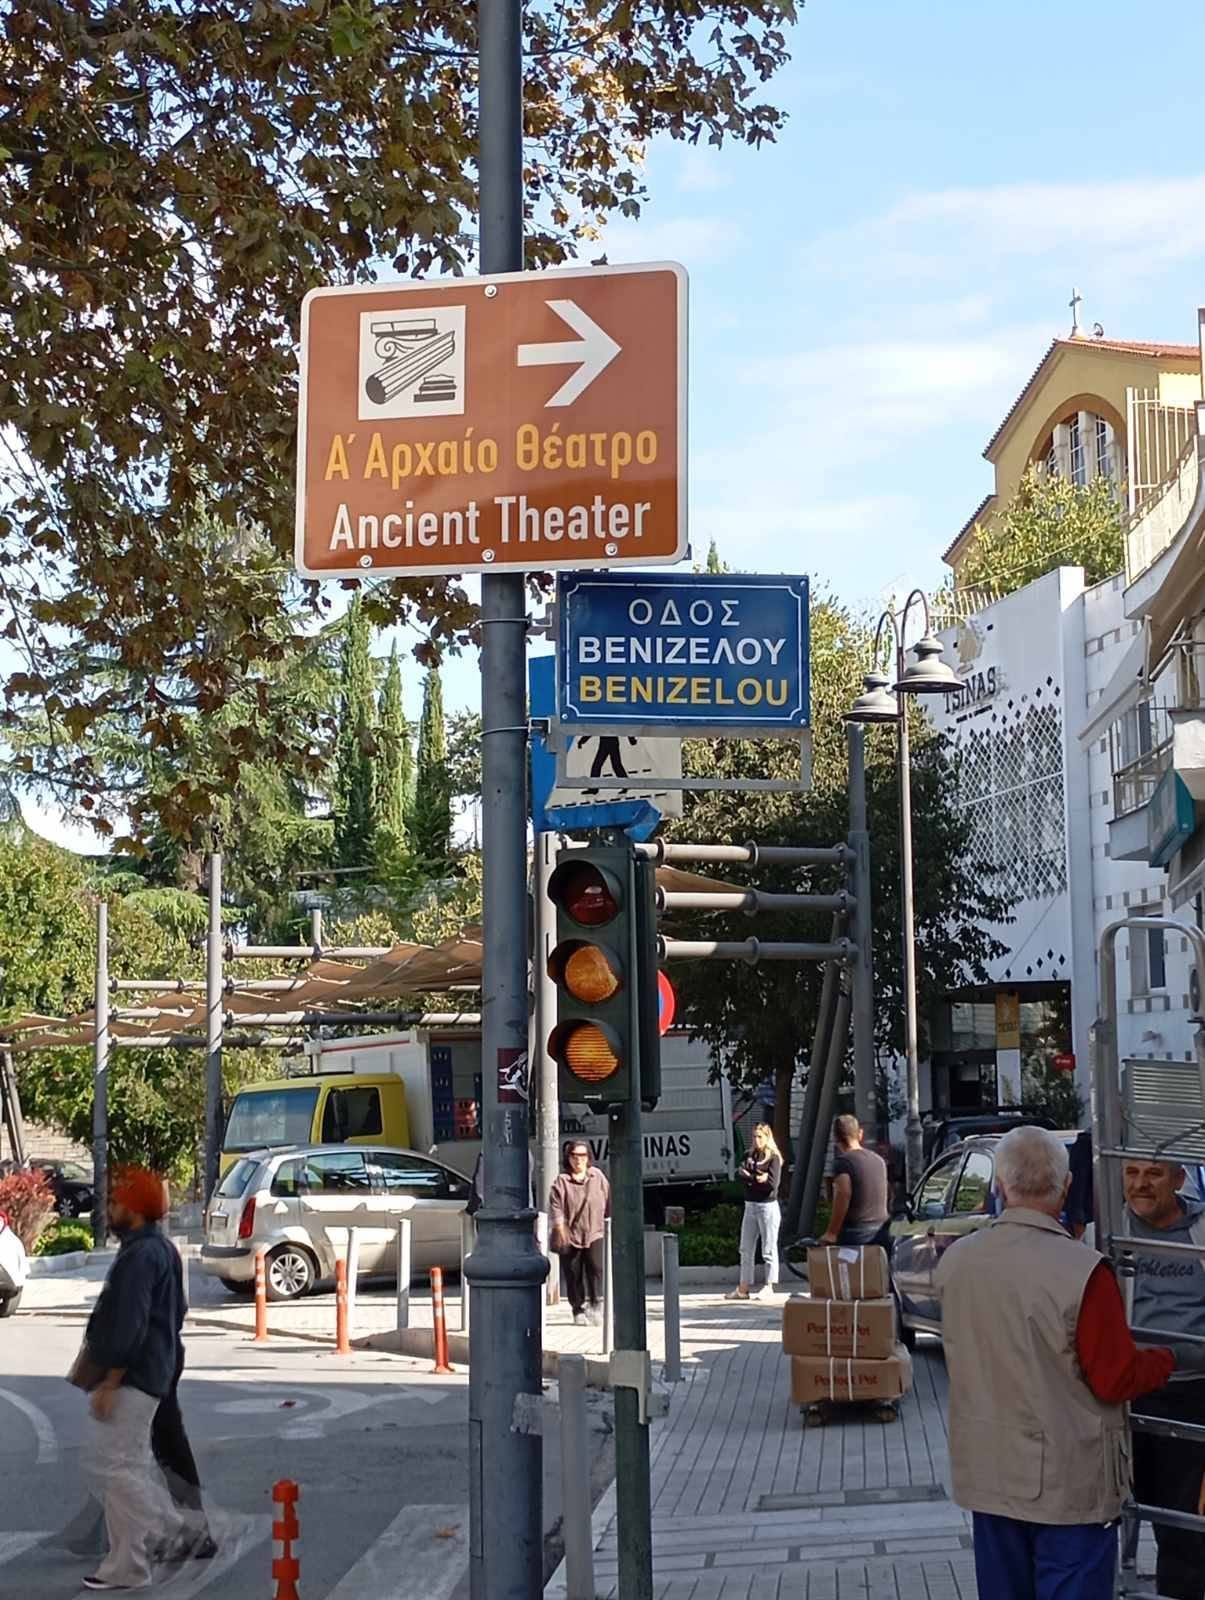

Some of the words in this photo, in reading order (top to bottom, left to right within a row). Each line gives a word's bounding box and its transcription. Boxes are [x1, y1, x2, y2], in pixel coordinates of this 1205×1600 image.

[363, 427, 498, 490] Αρχαίο
[329, 501, 481, 550] Ancient
[494, 495, 652, 544] Theater
[628, 598, 740, 627] ΟΔΟΣ
[578, 636, 787, 666] ΒΕΝΙΖΕΛΟΥ
[578, 675, 788, 706] BENIZELOU
